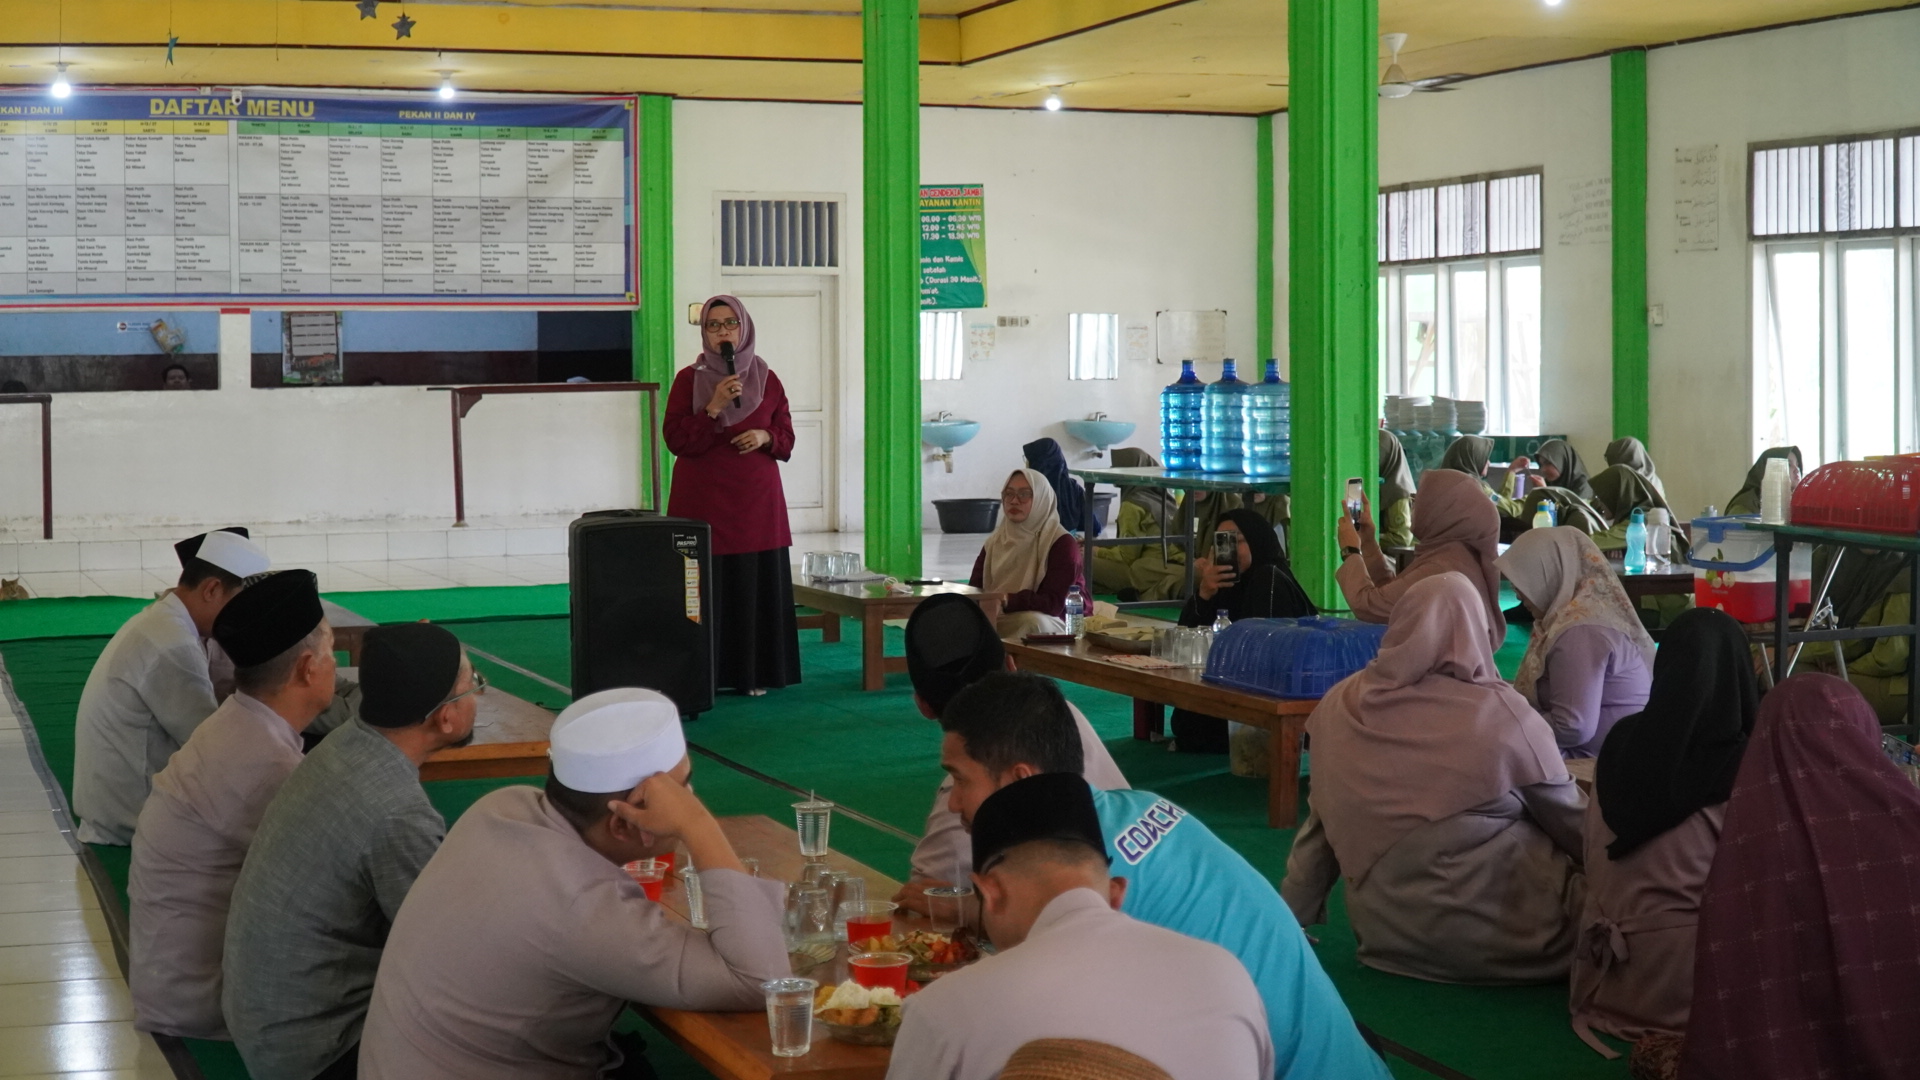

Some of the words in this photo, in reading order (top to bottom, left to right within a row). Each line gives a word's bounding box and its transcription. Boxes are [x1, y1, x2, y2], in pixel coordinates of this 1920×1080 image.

[150, 98, 240, 115] DAFTAR
[247, 100, 314, 116] MENU
[399, 110, 432, 118] PEKAN
[920, 188, 929, 198] AN
[1115, 800, 1187, 864] COACH
